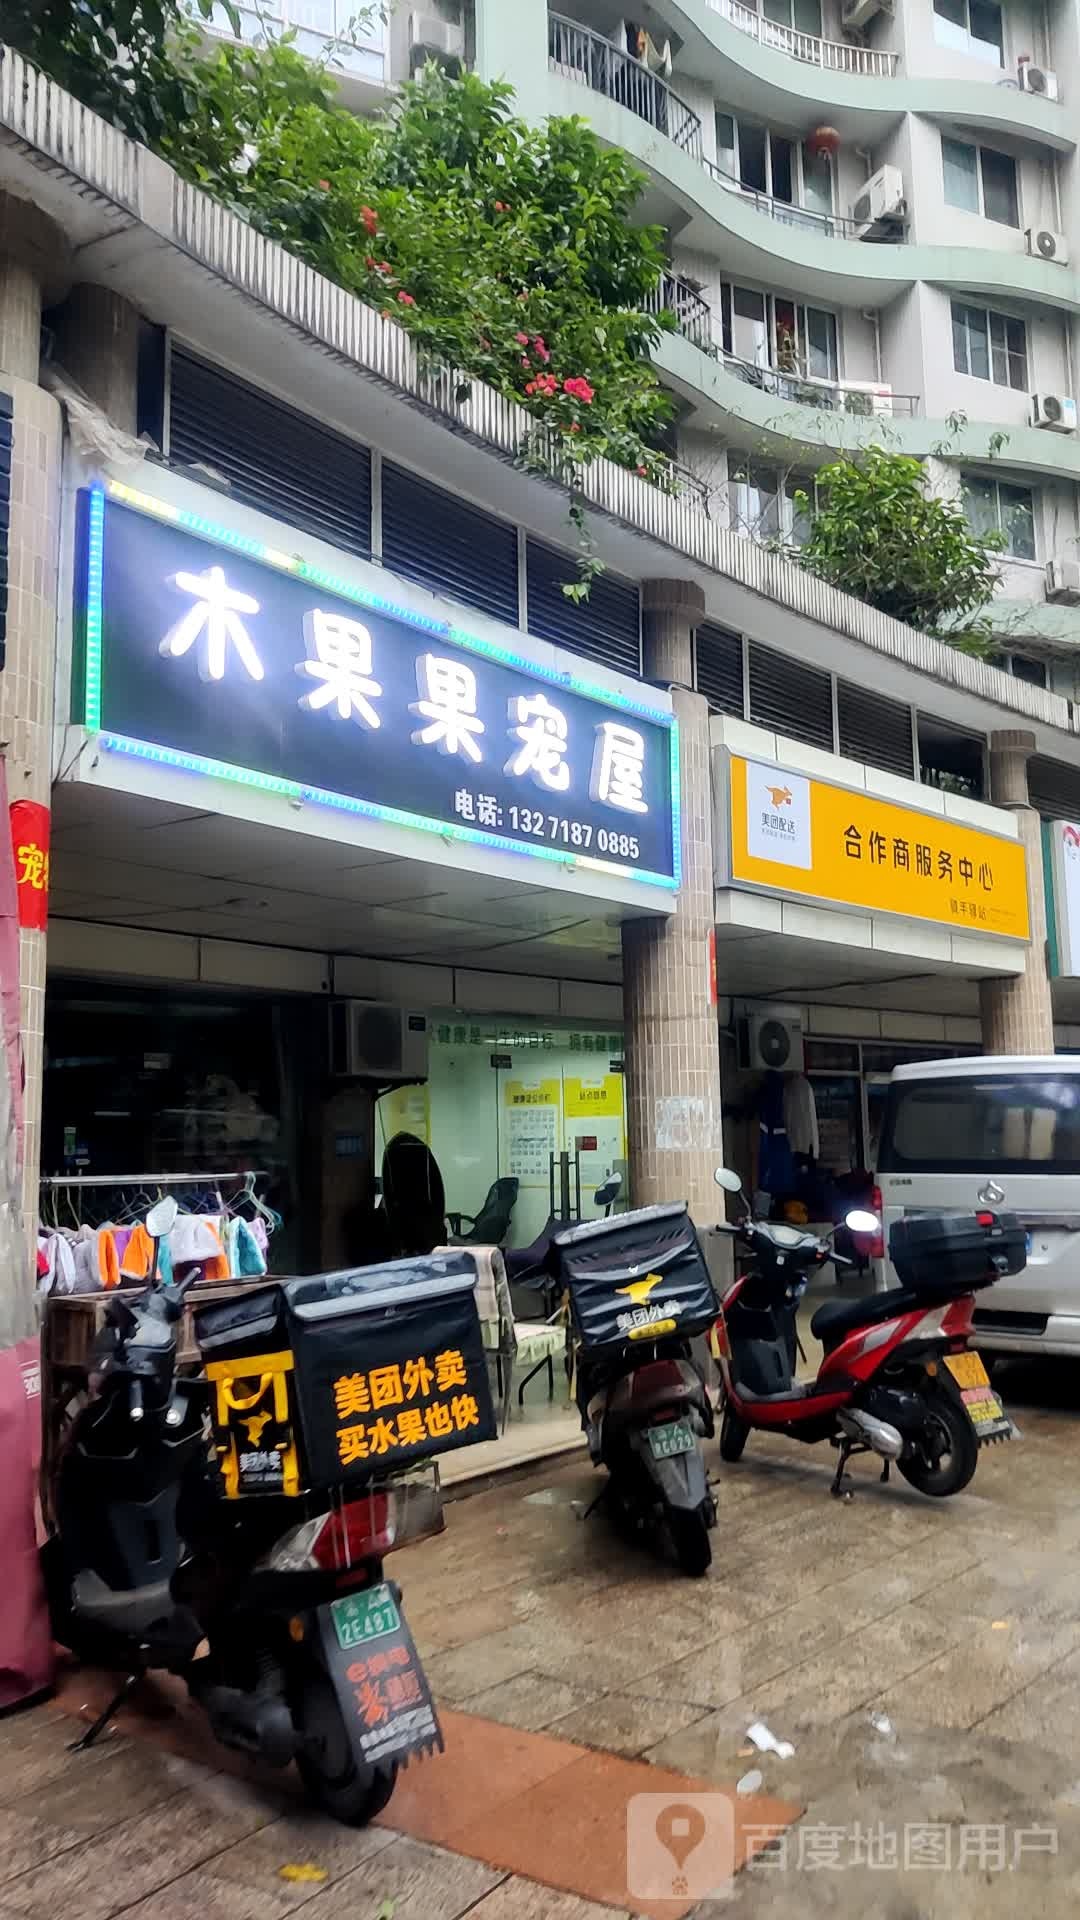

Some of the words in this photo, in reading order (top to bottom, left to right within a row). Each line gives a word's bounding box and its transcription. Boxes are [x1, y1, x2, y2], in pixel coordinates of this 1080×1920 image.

[159, 566, 649, 814] 木果果宠屋
[455, 788, 503, 827] 电话:
[508, 806, 545, 836] 132
[548, 816, 593, 848] 7187
[597, 828, 640, 859] 0885
[761, 812, 796, 834] 美团配送
[844, 824, 994, 891] 合作商服务中心
[616, 1300, 682, 1332] 美团外卖
[333, 1349, 468, 1420] 美团外卖
[336, 1393, 480, 1467] 买水果也快
